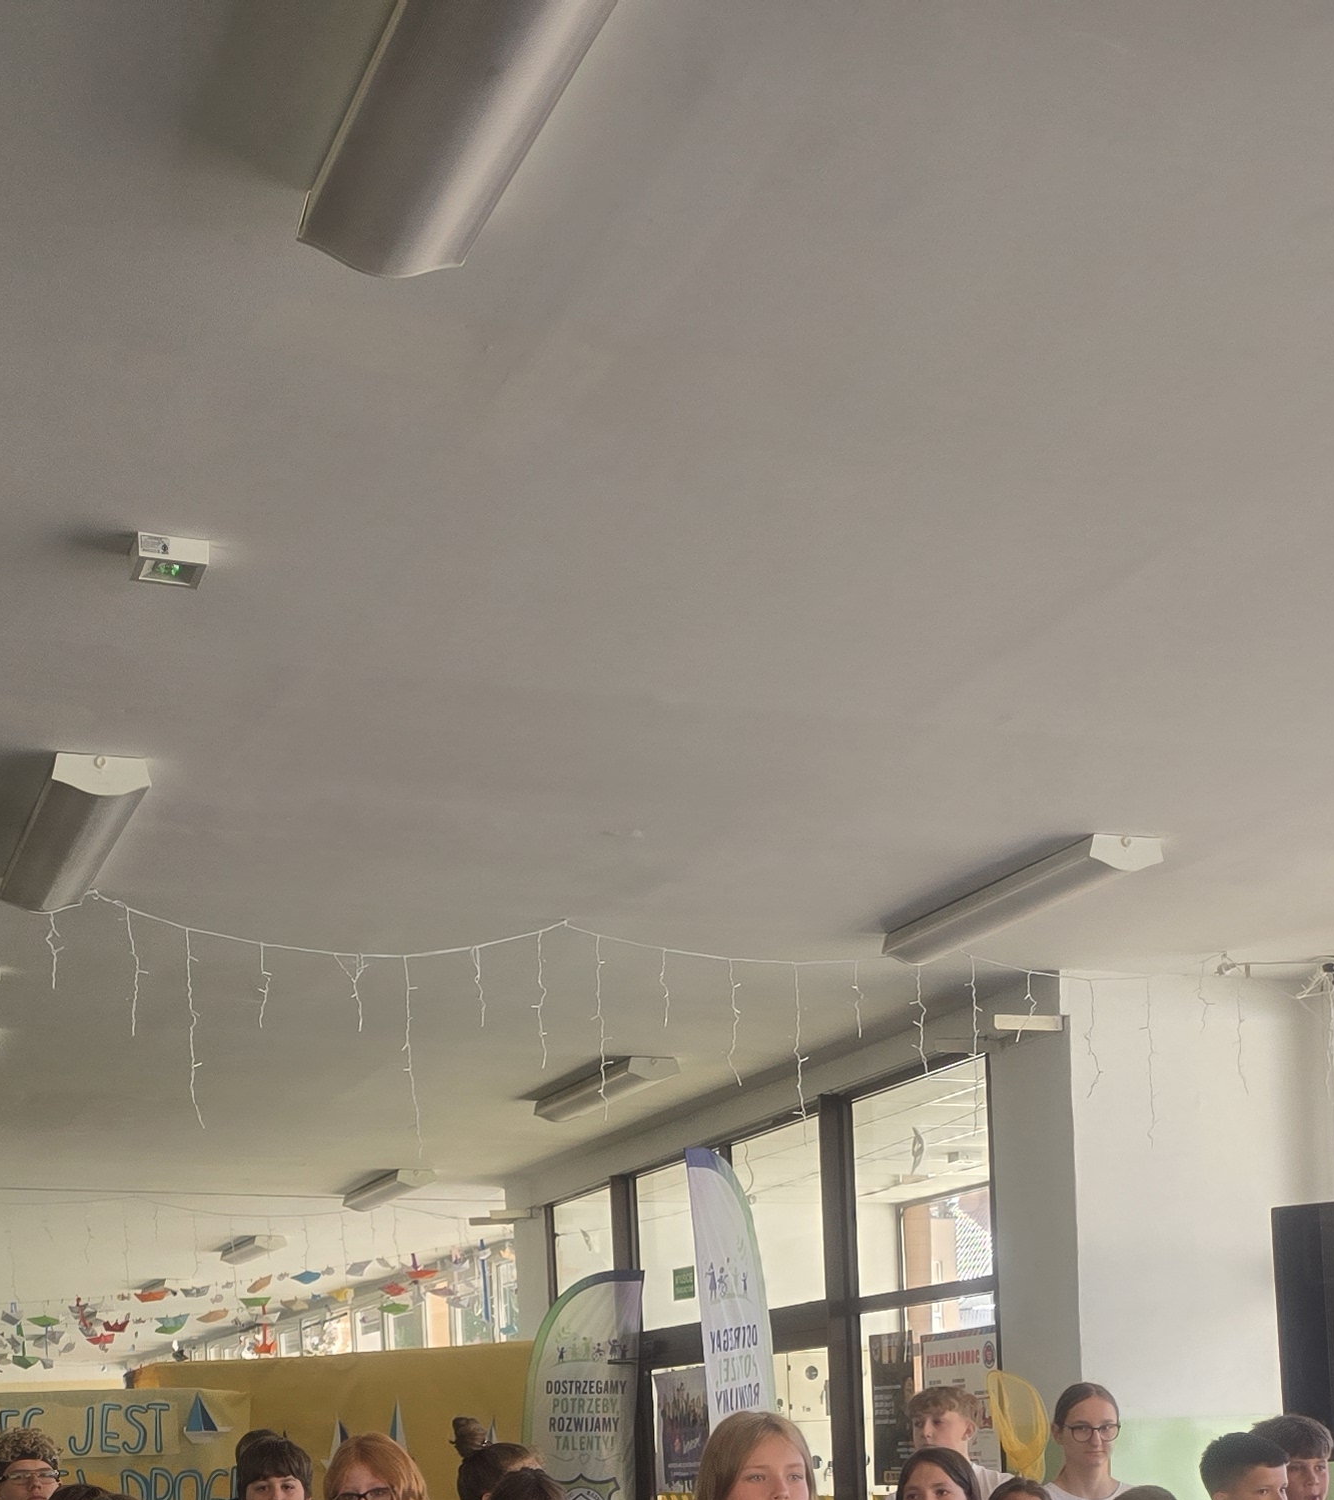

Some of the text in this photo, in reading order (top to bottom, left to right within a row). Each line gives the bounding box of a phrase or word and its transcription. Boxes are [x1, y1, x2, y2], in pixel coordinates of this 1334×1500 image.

[546, 1380, 627, 1395] DOSTRZEGAMY
[552, 1398, 620, 1416] POTRZEBY,
[68, 1402, 170, 1456] JEST
[548, 1417, 620, 1432] ROZWIJAMY
[554, 1435, 615, 1451] TALENTY!
